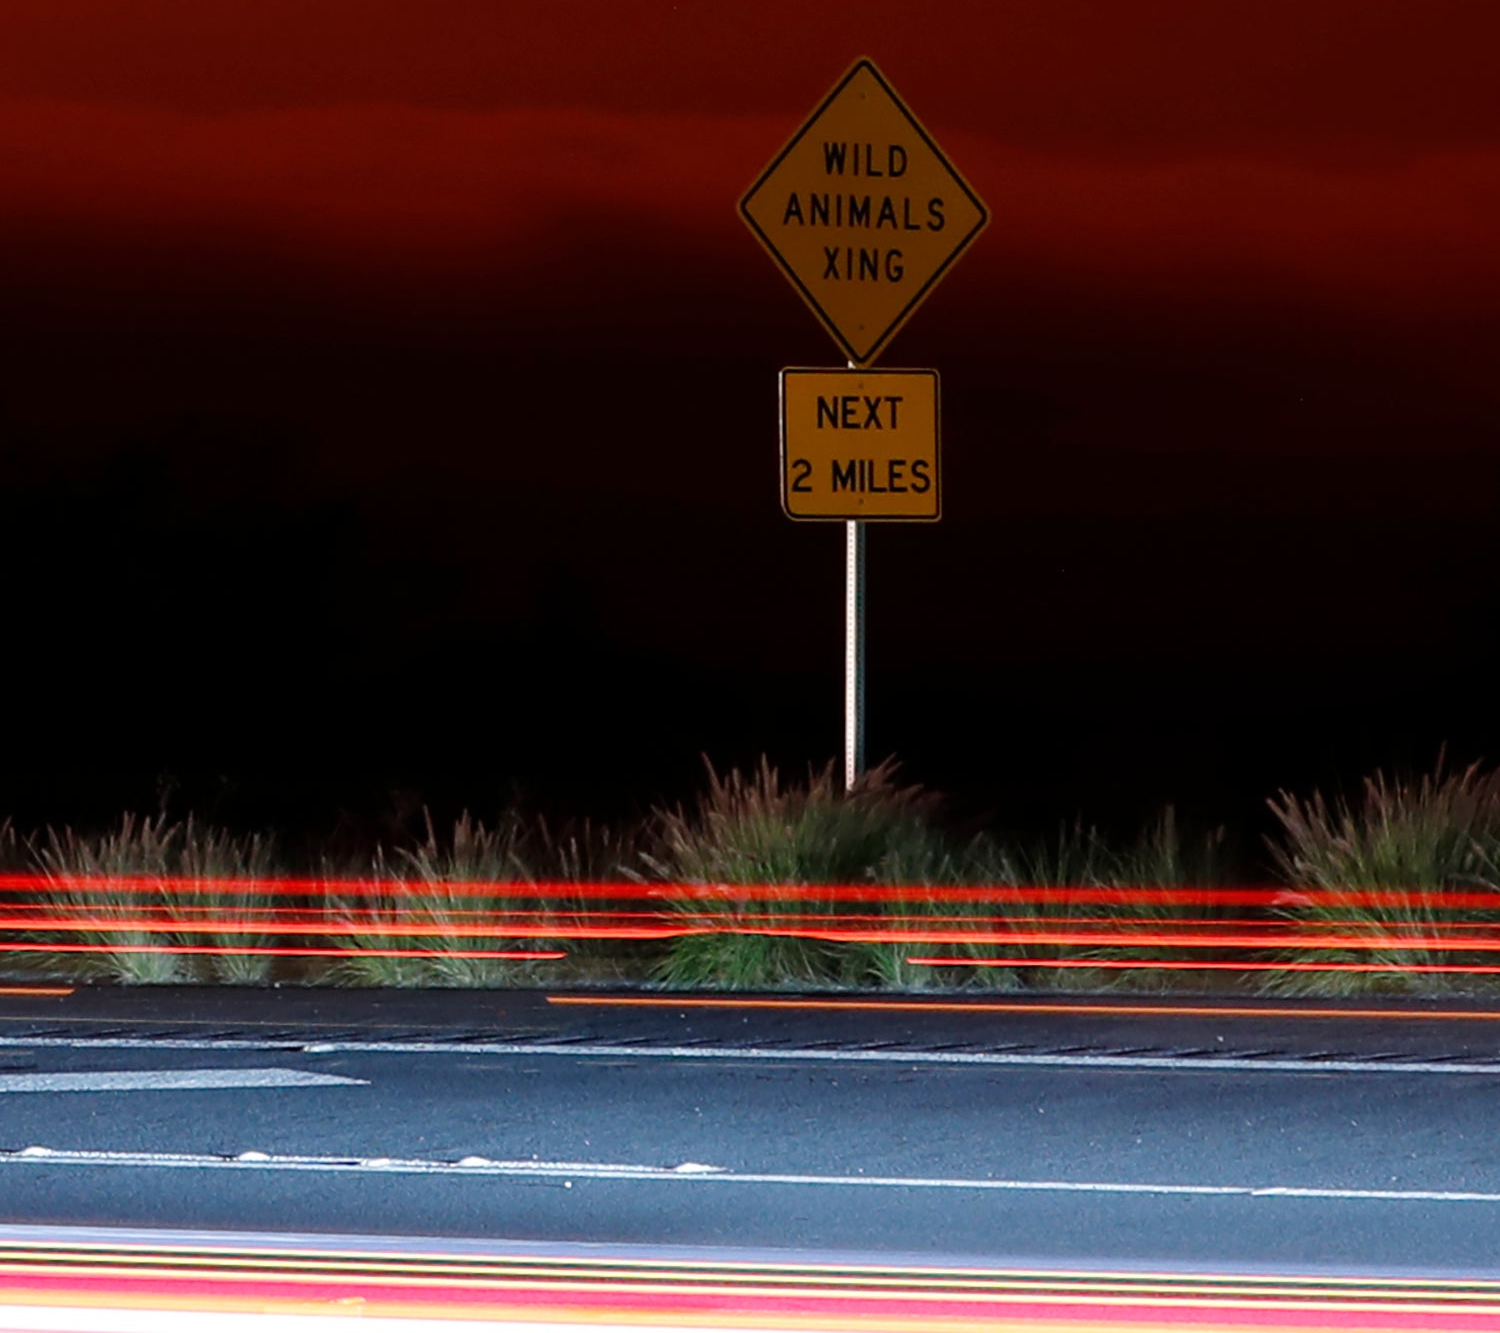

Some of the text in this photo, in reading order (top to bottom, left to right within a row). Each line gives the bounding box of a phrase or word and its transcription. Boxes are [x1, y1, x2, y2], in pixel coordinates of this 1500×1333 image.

[823, 141, 908, 178] WILD
[782, 192, 946, 232] ANIMALS
[823, 246, 904, 283] XING
[816, 396, 903, 429] NEXT
[792, 458, 931, 493] 2 MILES
